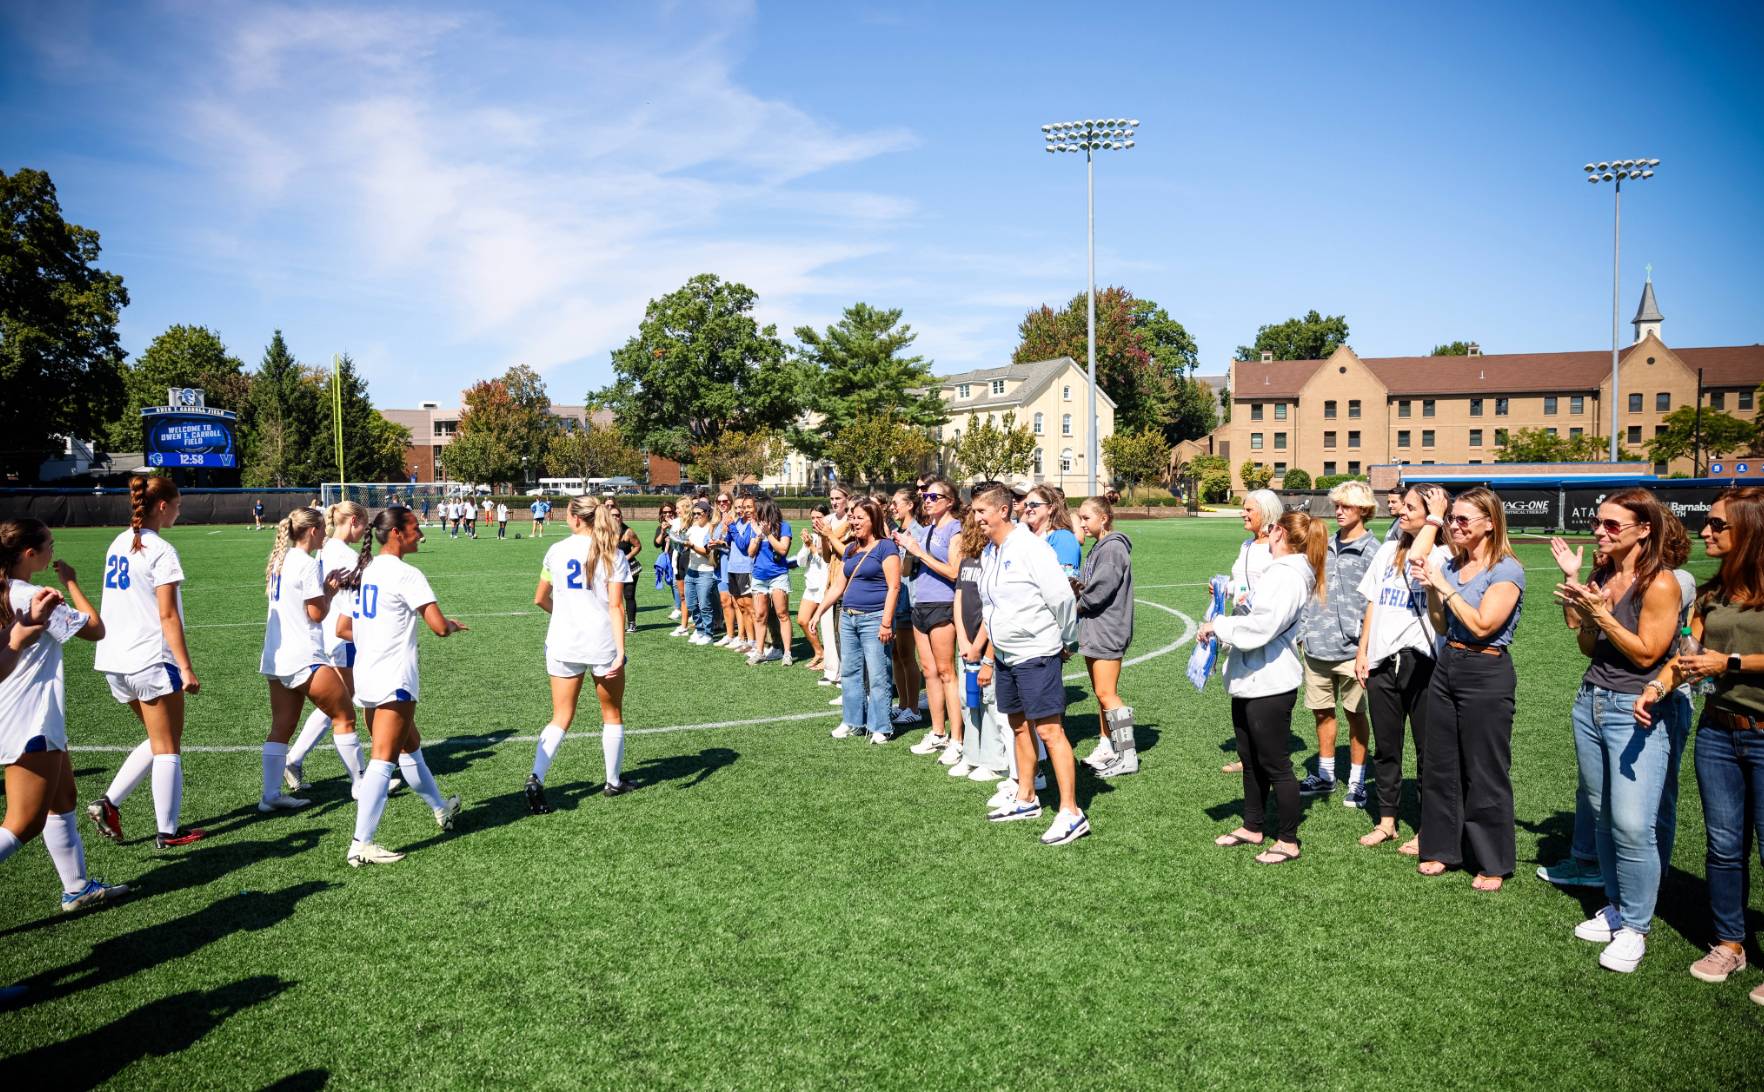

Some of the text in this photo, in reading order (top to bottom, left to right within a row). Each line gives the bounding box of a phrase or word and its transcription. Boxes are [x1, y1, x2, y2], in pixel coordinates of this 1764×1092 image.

[180, 454, 204, 465] 12:58
[1504, 500, 1549, 510] AG-ONE
[1671, 501, 1712, 512] Barnaba
[1572, 507, 1600, 518] ATA
[105, 554, 131, 590] 28
